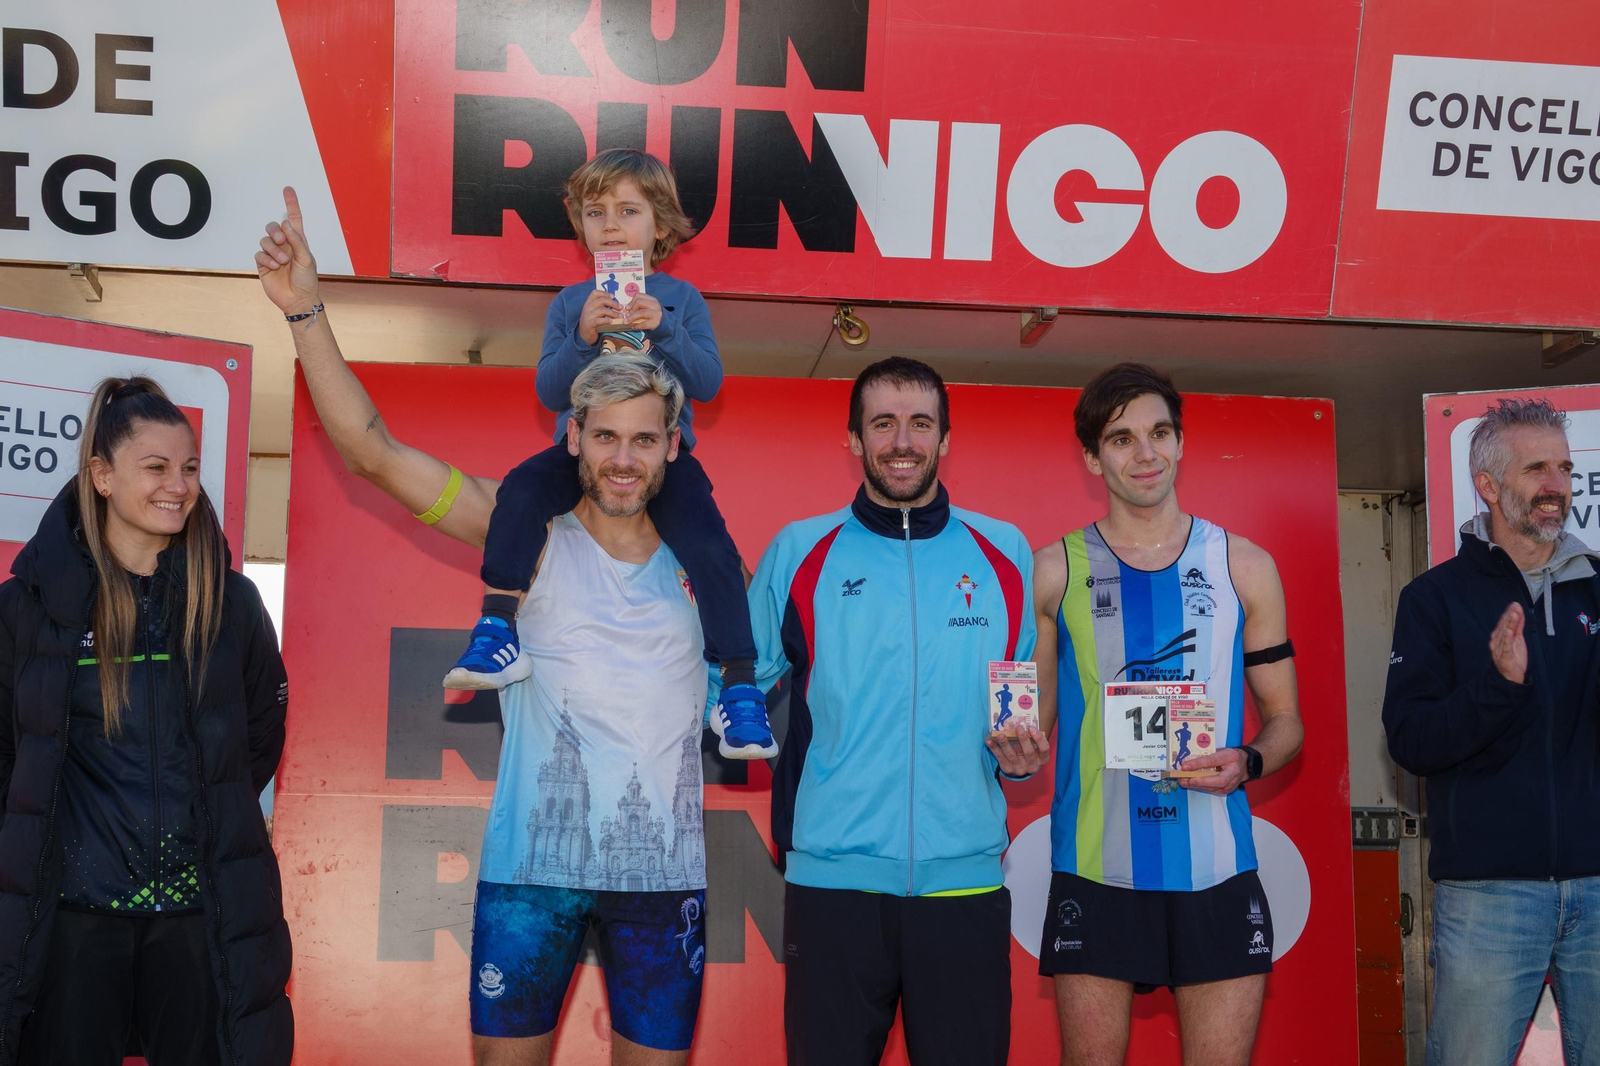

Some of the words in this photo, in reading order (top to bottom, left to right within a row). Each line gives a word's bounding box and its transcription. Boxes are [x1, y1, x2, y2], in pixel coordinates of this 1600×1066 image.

[2, 27, 154, 117] DE
[1432, 141, 1492, 180] DE
[0, 151, 212, 241] IGO
[1146, 667, 1177, 675] Talleres
[1137, 806, 1177, 819] MGM
